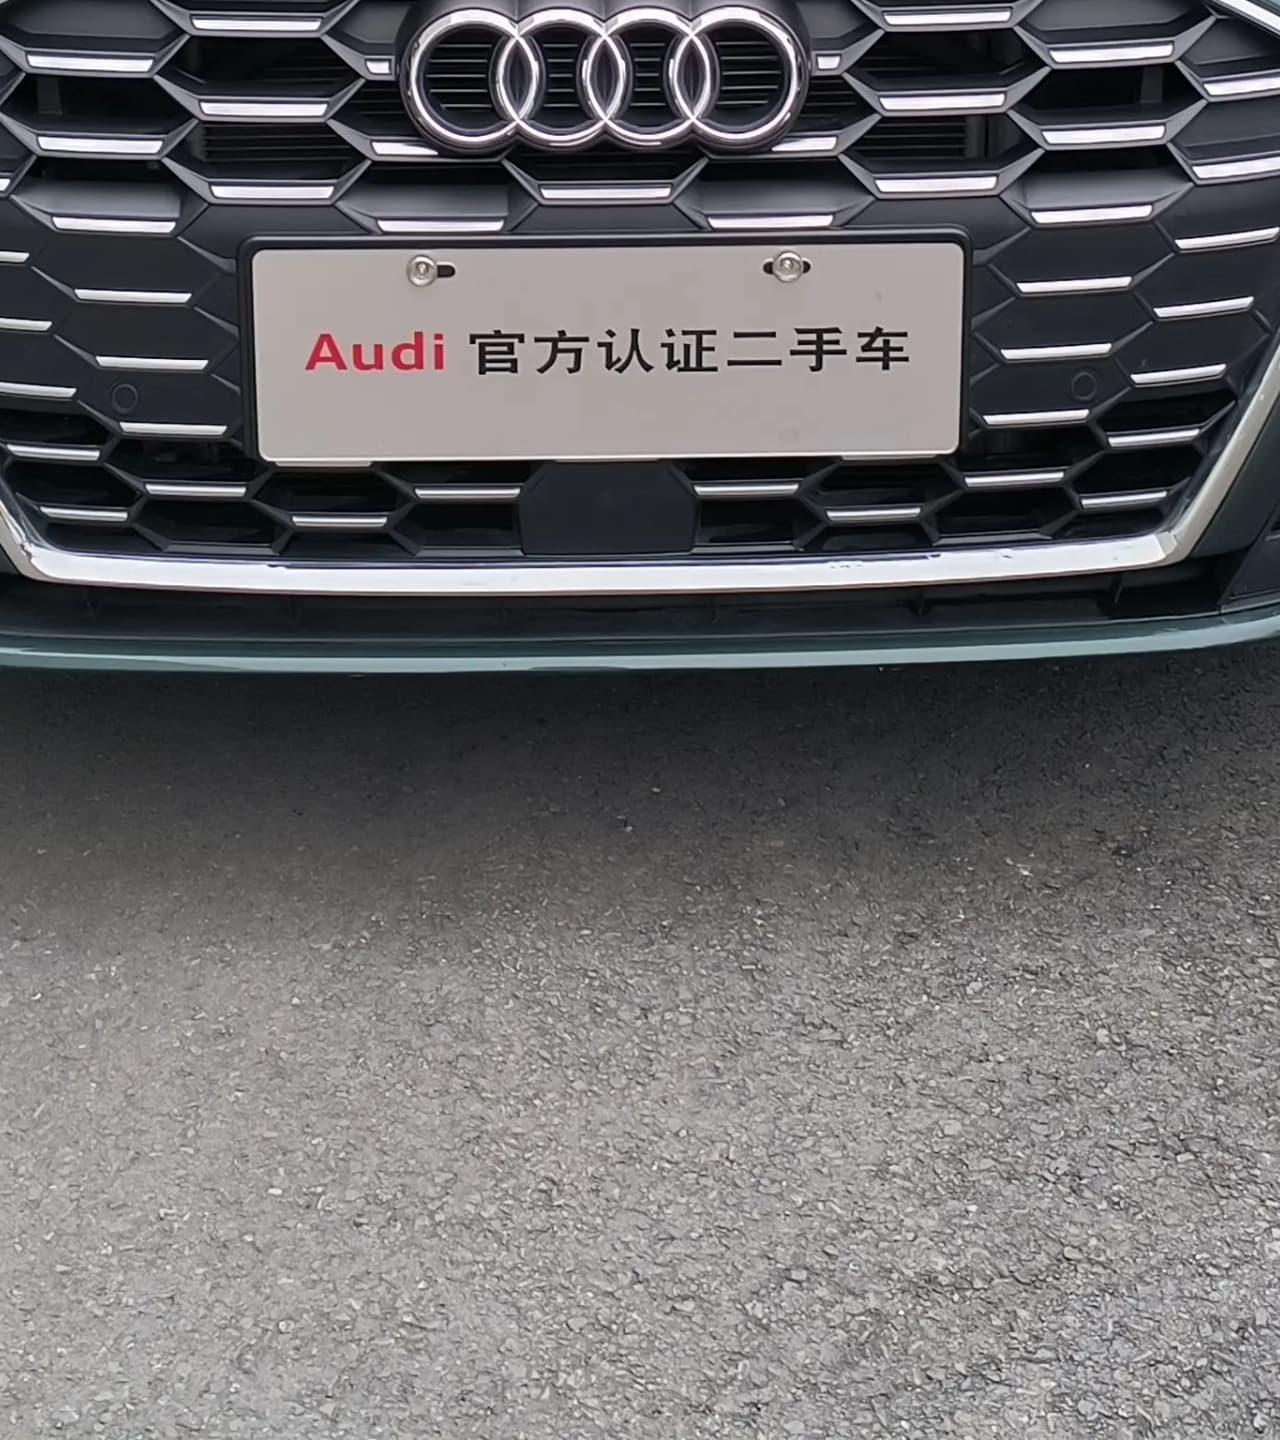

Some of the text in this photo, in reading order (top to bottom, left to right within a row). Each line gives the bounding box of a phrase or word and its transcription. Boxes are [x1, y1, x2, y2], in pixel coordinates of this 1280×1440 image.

[305, 326, 911, 376] Audi 官方认证二手车
